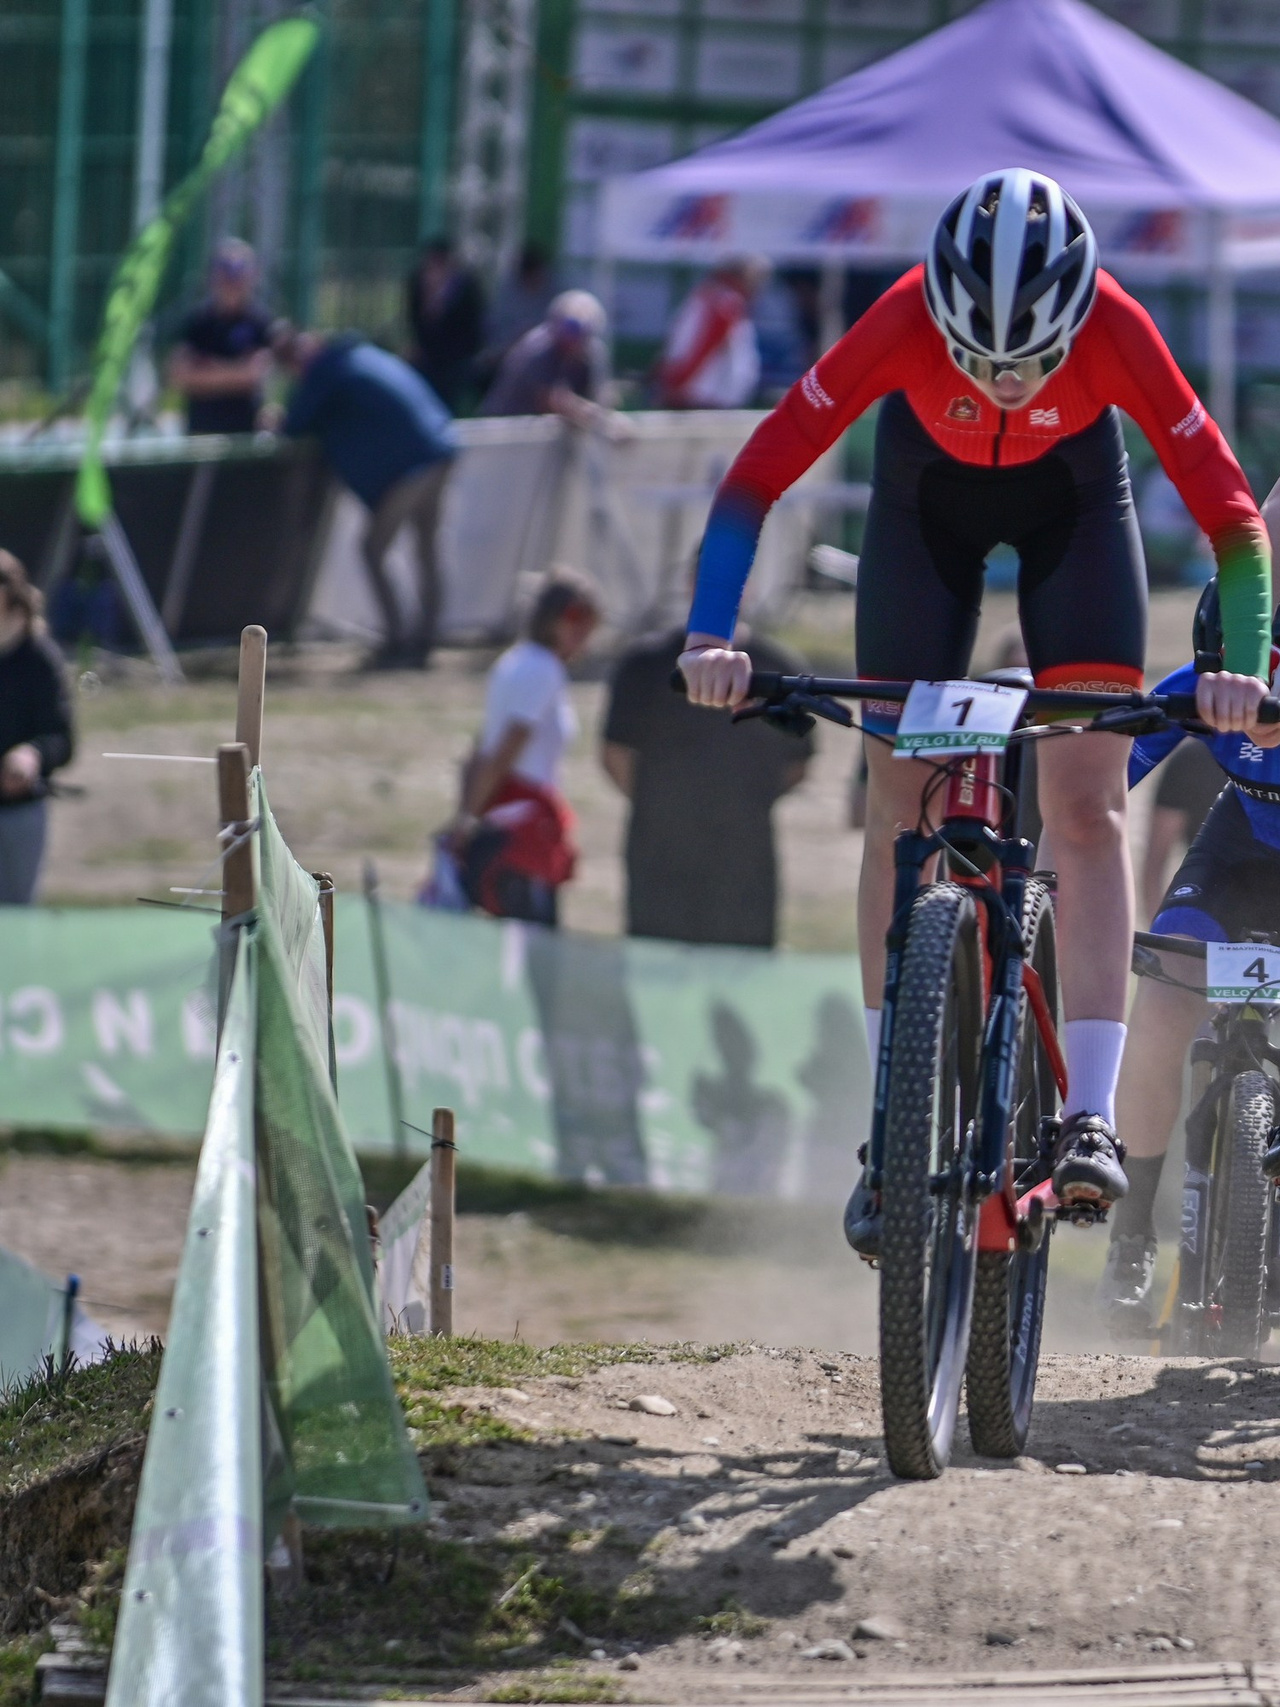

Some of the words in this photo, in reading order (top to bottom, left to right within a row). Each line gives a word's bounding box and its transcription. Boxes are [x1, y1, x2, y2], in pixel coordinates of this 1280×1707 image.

[951, 696, 975, 727] 1
[902, 733, 1000, 748] VELOTV.RU
[1243, 957, 1270, 983] 4
